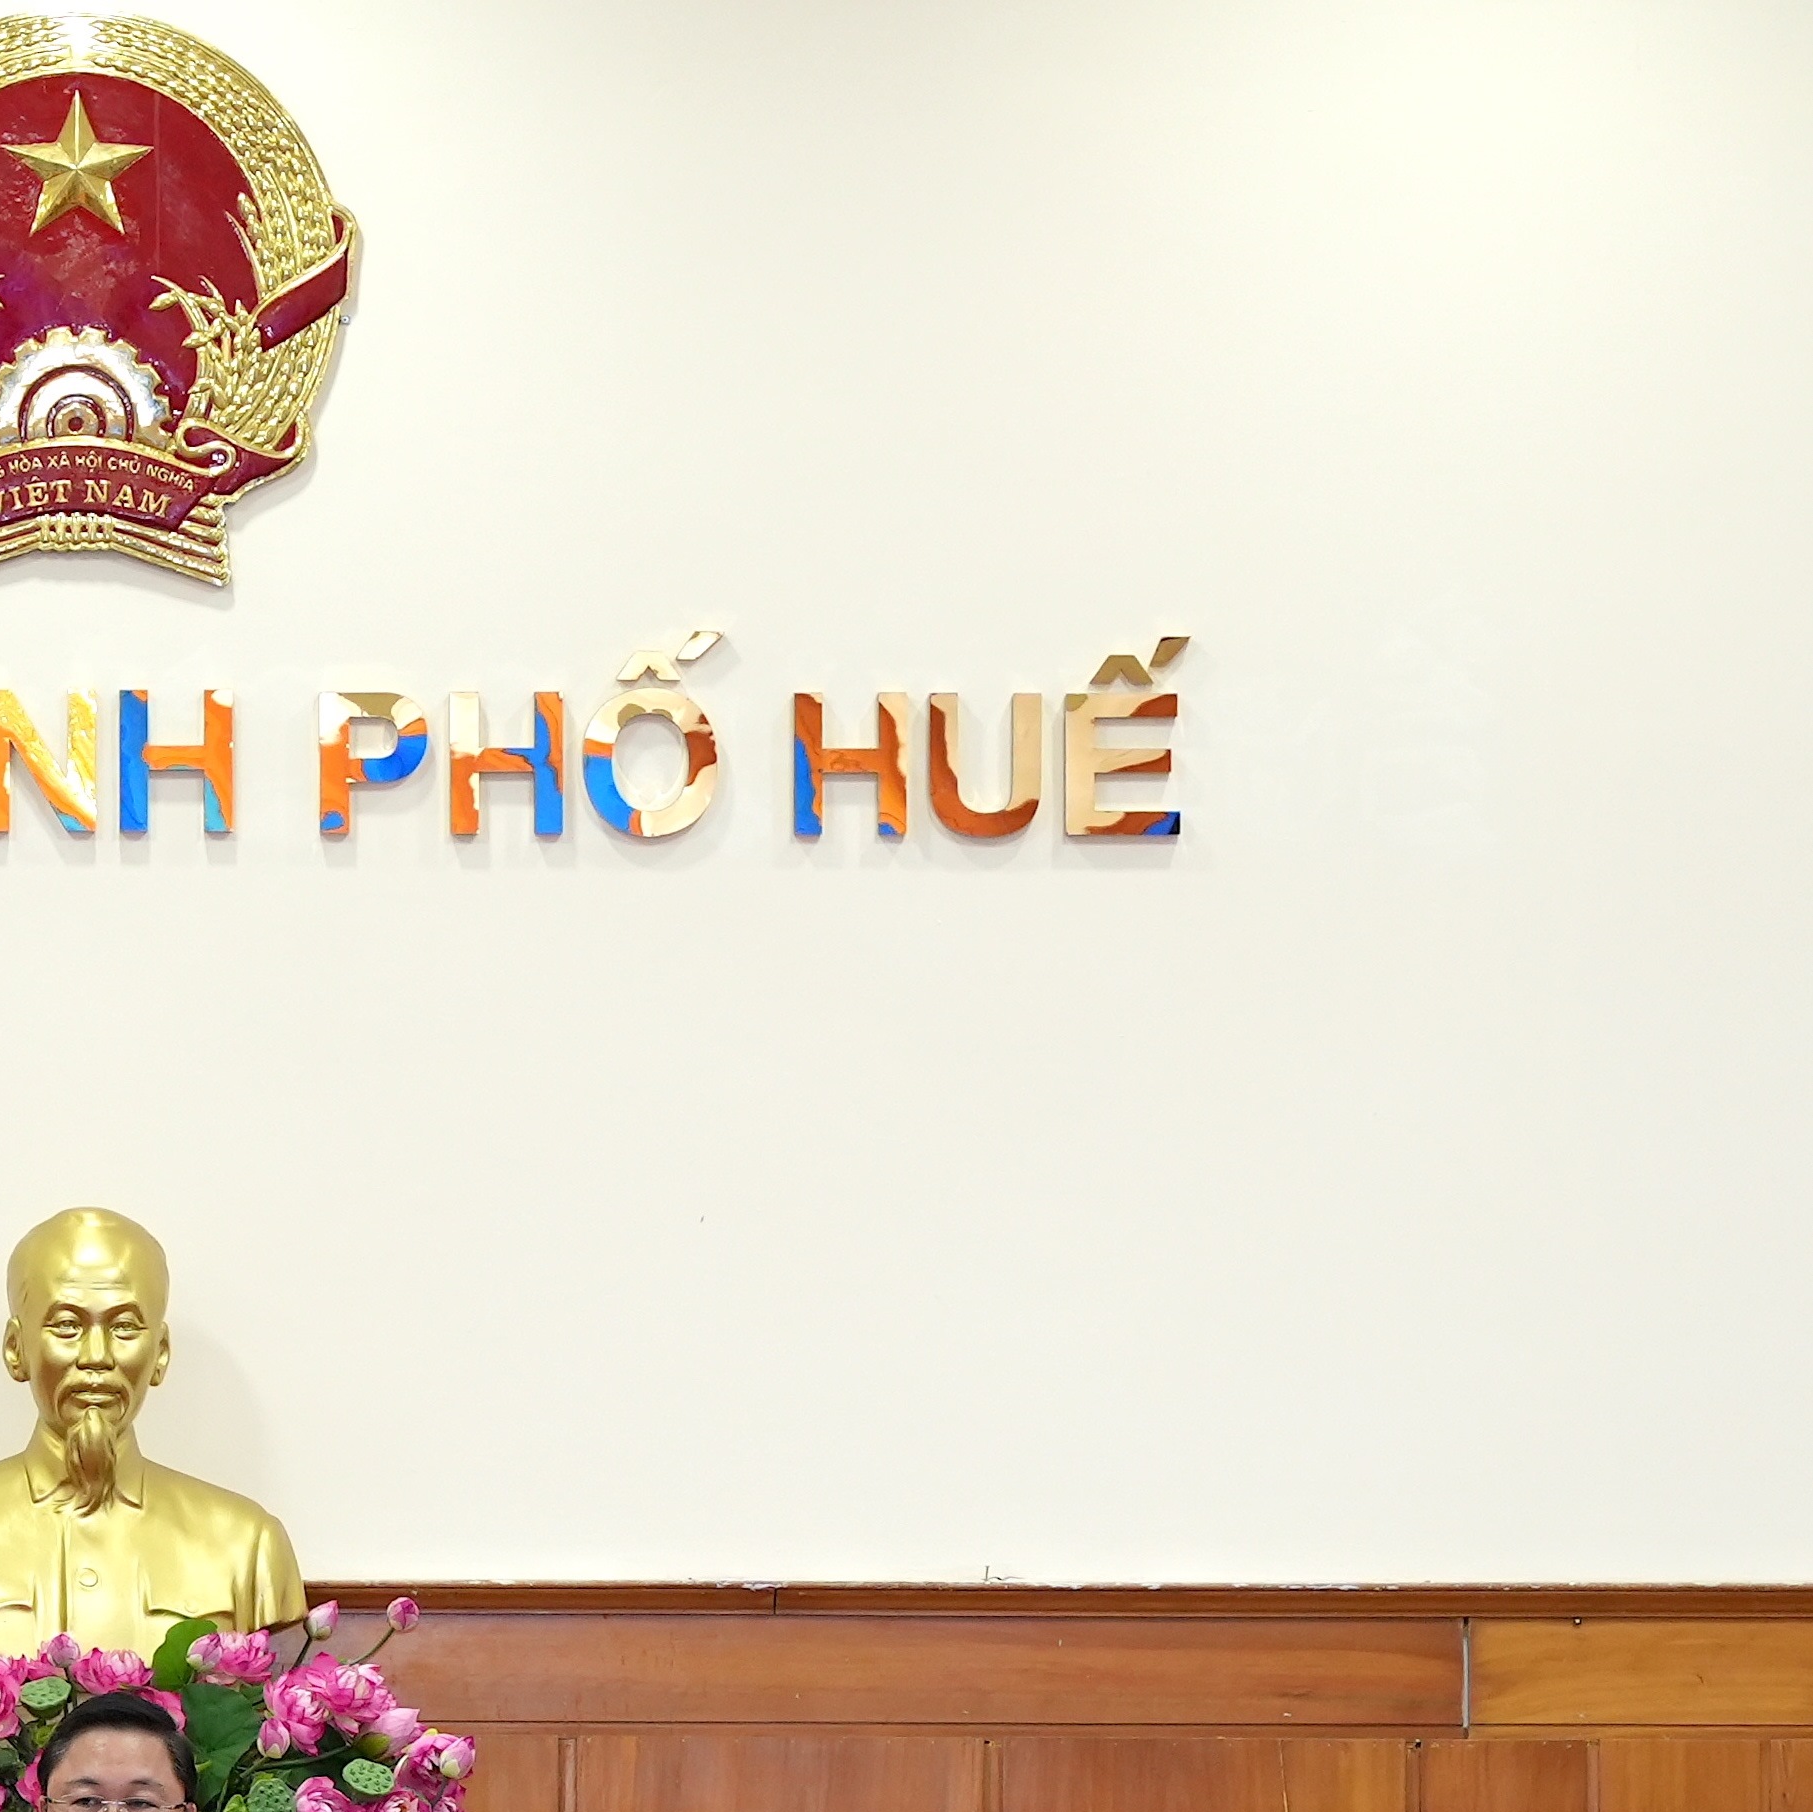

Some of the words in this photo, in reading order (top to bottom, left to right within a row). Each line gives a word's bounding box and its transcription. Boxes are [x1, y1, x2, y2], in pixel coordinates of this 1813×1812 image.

[8, 454, 42, 474] HÒA
[76, 451, 102, 473] HỘI
[107, 455, 140, 473] CHỦ
[146, 464, 194, 493] NGHĨA
[84, 480, 172, 517] NAM
[318, 631, 725, 837] PHỐ
[793, 636, 1191, 837] HUẾ
